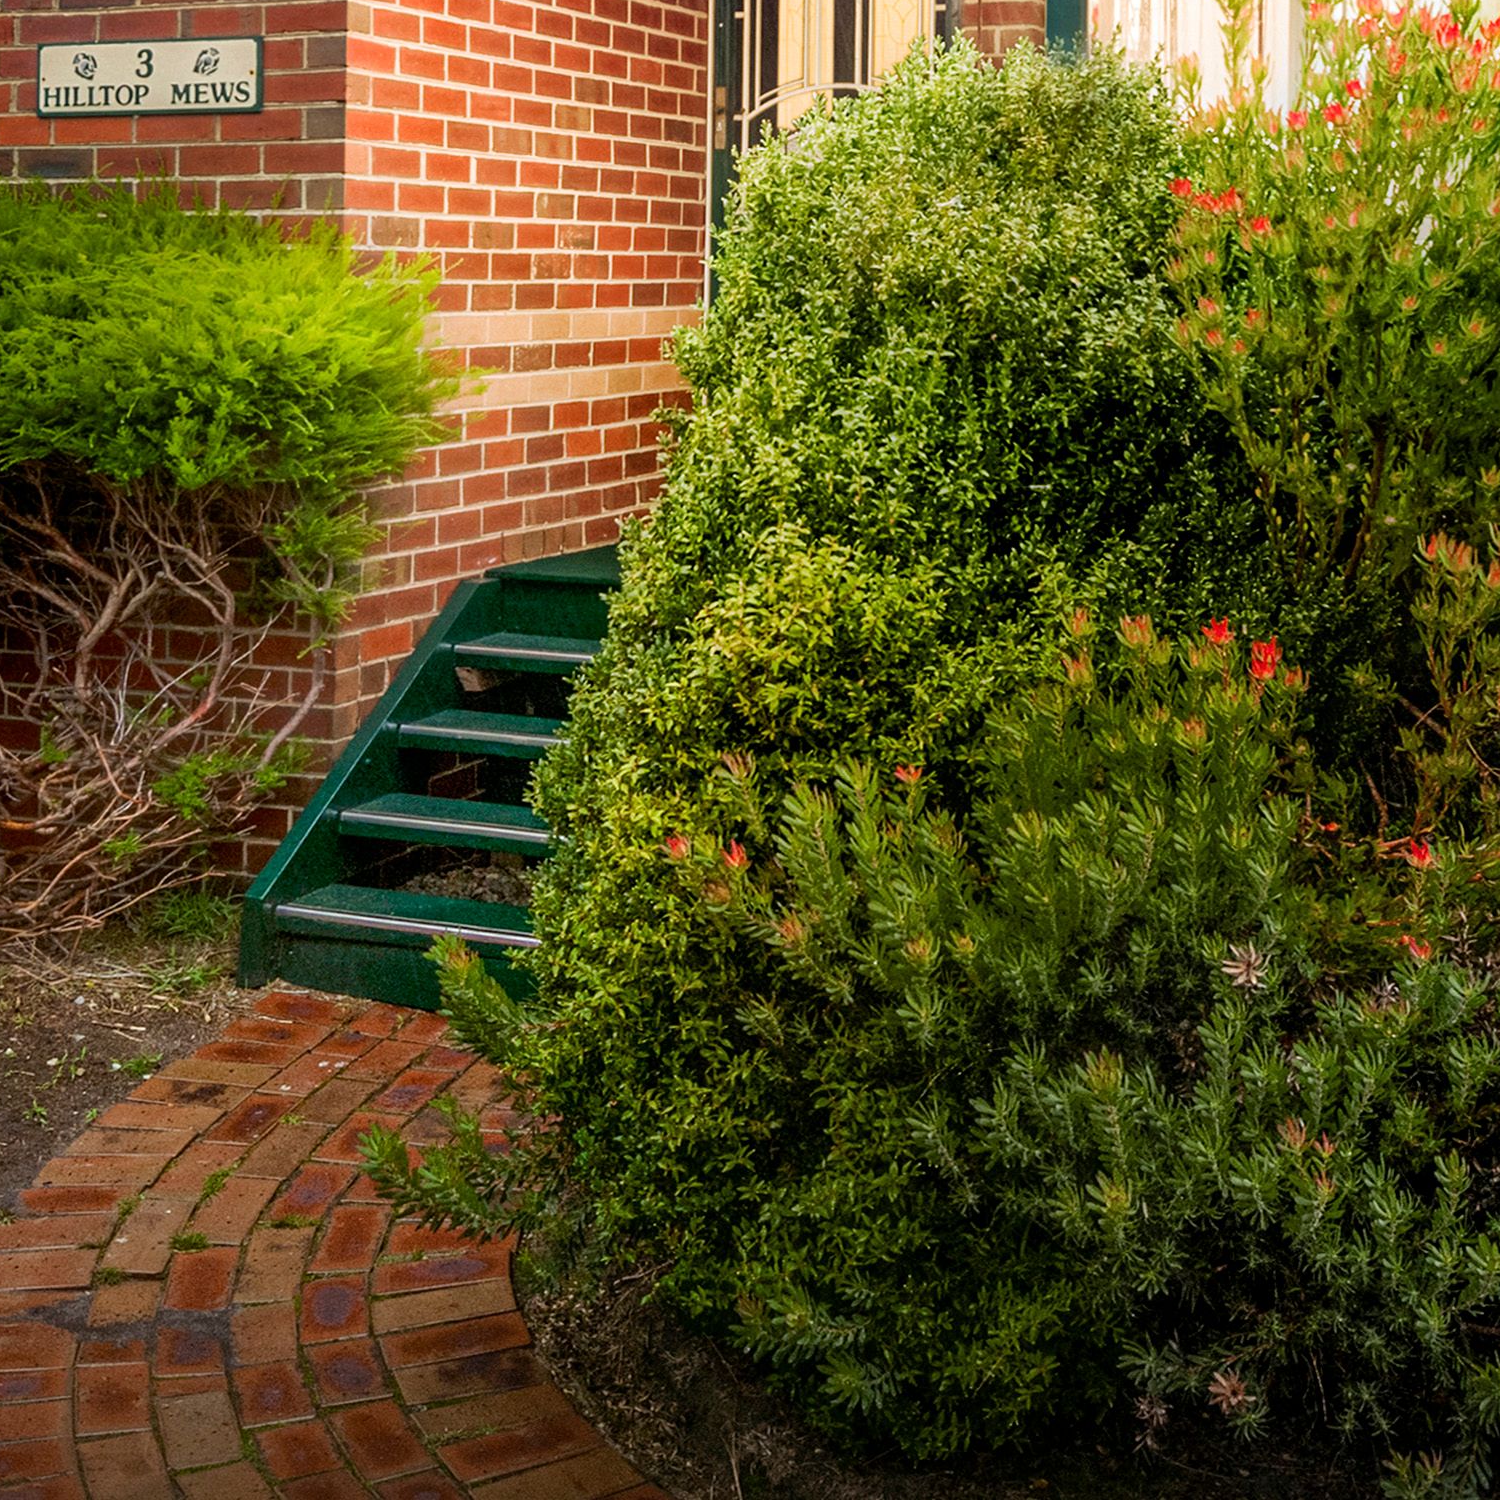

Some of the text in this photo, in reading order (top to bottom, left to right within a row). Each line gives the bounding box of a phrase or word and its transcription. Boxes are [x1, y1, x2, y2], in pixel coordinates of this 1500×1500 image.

[135, 49, 154, 78] 3
[43, 81, 250, 107] HILLTOP MEWS
